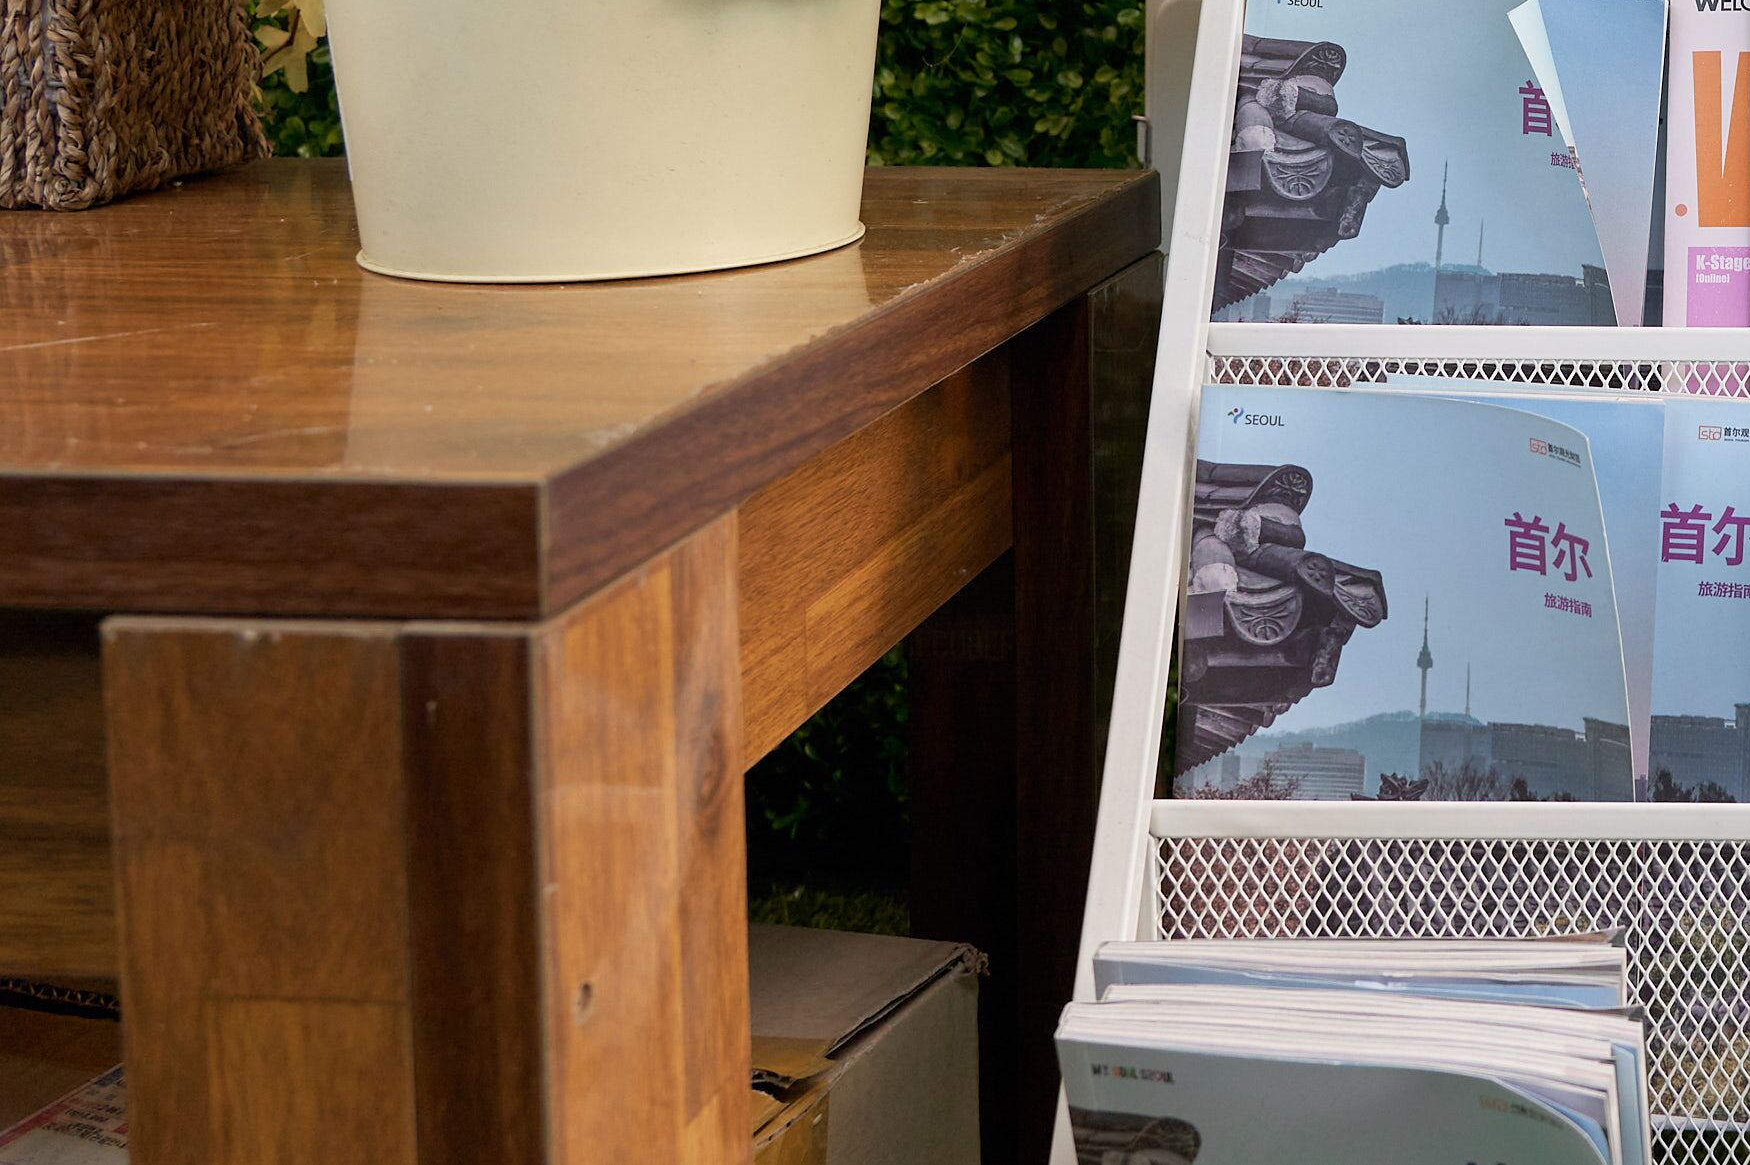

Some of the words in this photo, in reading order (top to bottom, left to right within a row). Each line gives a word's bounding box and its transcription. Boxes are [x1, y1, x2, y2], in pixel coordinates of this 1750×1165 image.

[1695, 254, 1750, 272] K-Stage
[1244, 412, 1285, 428] SEOUL
[1504, 511, 1594, 583] 首尔
[1544, 591, 1593, 619] 旅游指南
